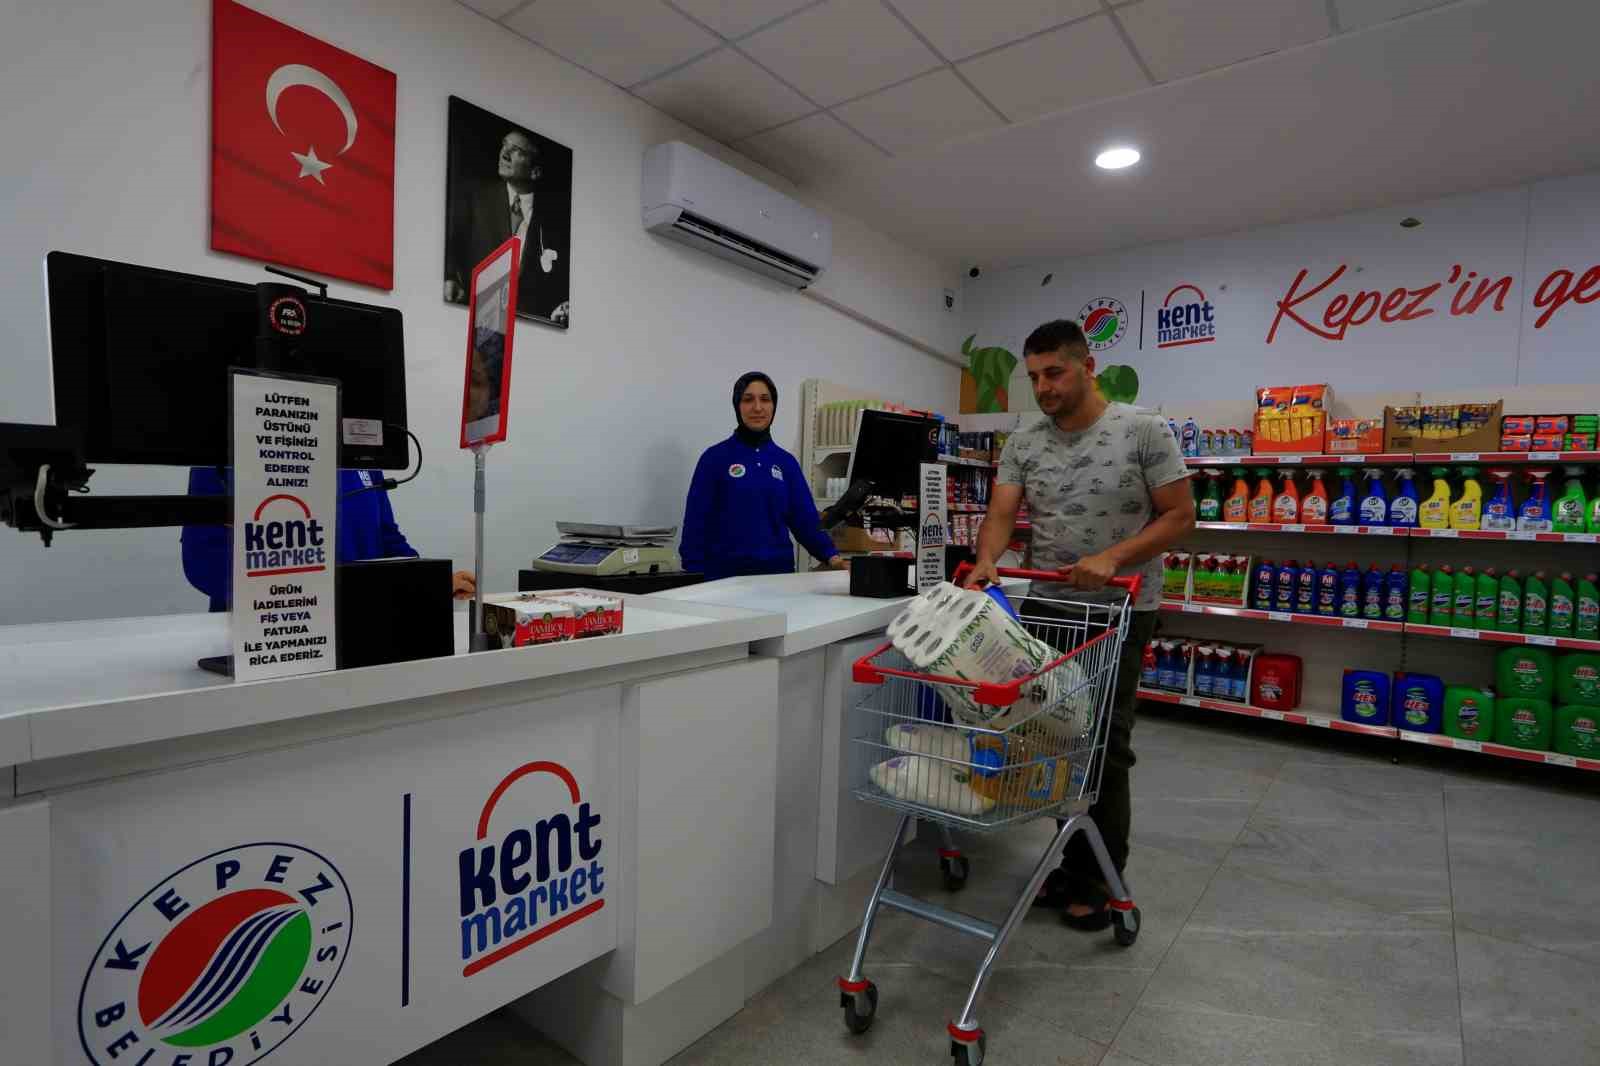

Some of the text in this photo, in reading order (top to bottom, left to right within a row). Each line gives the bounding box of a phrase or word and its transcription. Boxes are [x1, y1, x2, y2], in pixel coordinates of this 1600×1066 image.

[1266, 264, 1512, 344] Kepez'in
[1158, 301, 1214, 329] kent
[1158, 323, 1215, 343] market
[265, 392, 310, 406] LÜTFEN
[255, 407, 318, 421] PARANIZIN
[263, 420, 311, 433] ÜSTÜNÜ
[256, 435, 318, 448] VE FİŞİNİZİ
[259, 449, 315, 461] KONTROL
[264, 463, 310, 474] EDEREK
[266, 478, 309, 488] ALINIZ!
[245, 519, 324, 551] kent
[246, 547, 325, 569] market
[269, 584, 302, 596] ÜRÜN
[253, 596, 317, 610] İADELERİNİ
[260, 611, 311, 623] FİŞ VEYA
[263, 625, 309, 637] FATURA
[244, 636, 327, 653] İLE YAPMANIZI
[249, 648, 323, 666] RİCA EDERİZ.
[459, 803, 602, 917] kent
[104, 855, 334, 971] KEPEZ
[461, 860, 605, 960] market
